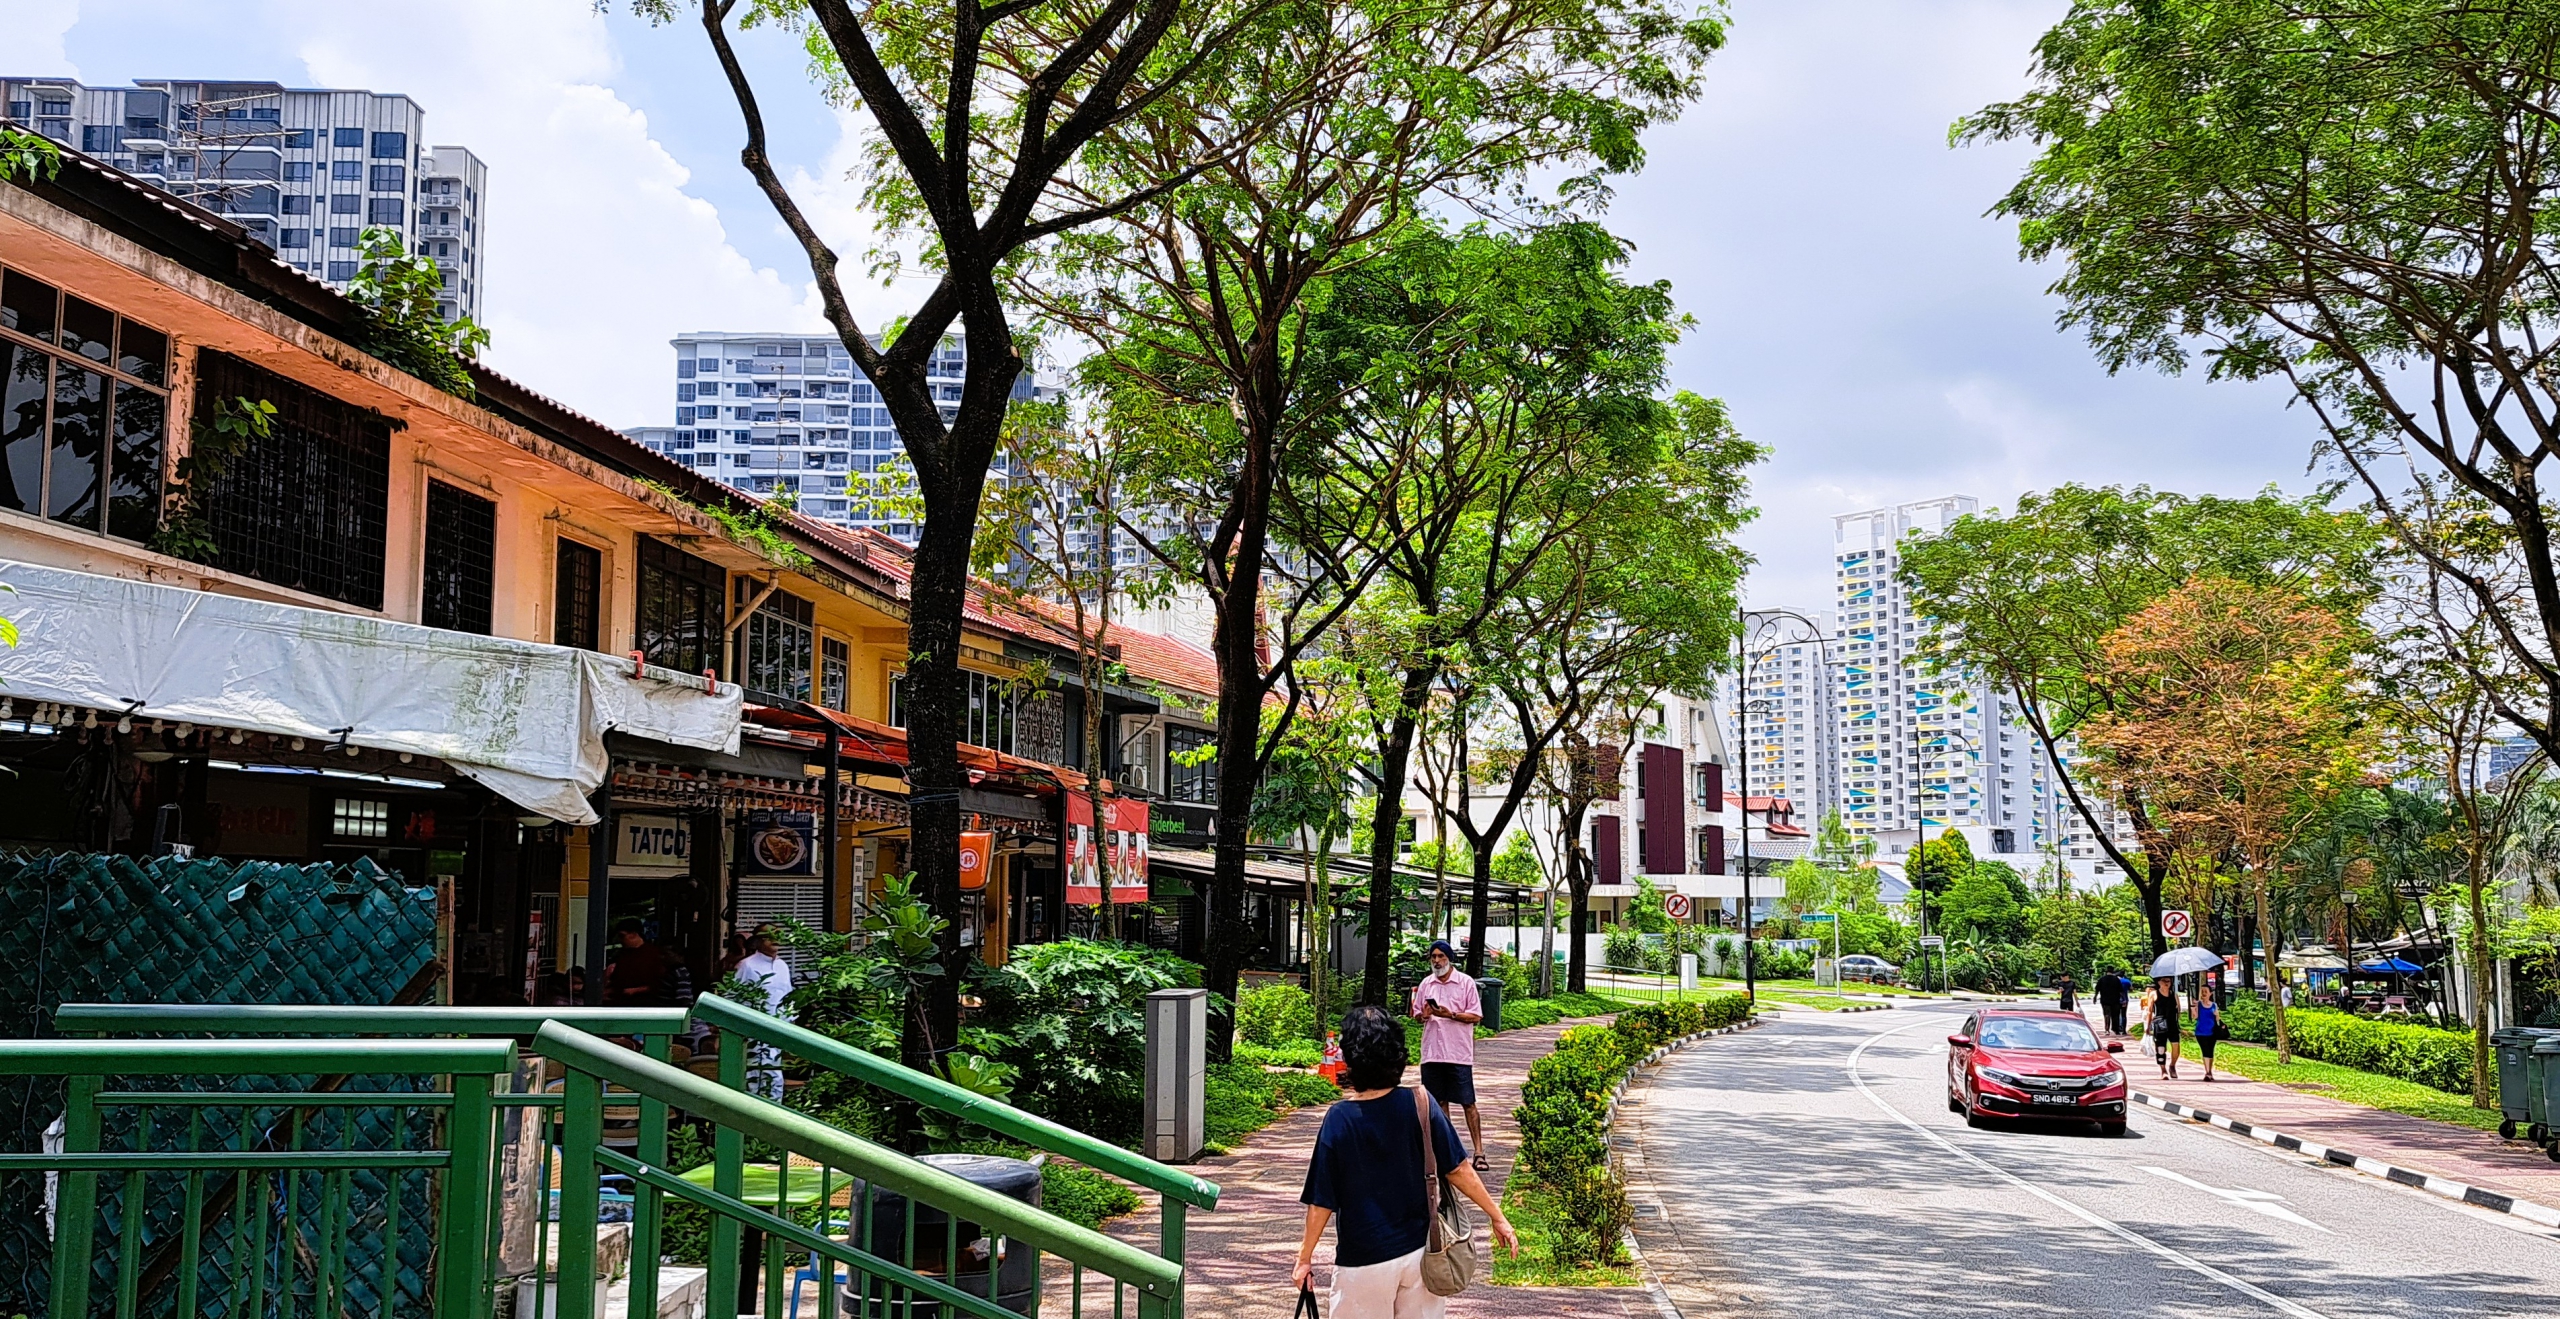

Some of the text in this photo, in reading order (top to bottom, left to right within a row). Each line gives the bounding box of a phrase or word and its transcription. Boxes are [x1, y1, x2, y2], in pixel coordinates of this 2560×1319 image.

[1149, 813, 1186, 834] nderbest
[629, 826, 687, 856] TATCO
[2033, 1094, 2076, 1104] SNQ 4815 J
